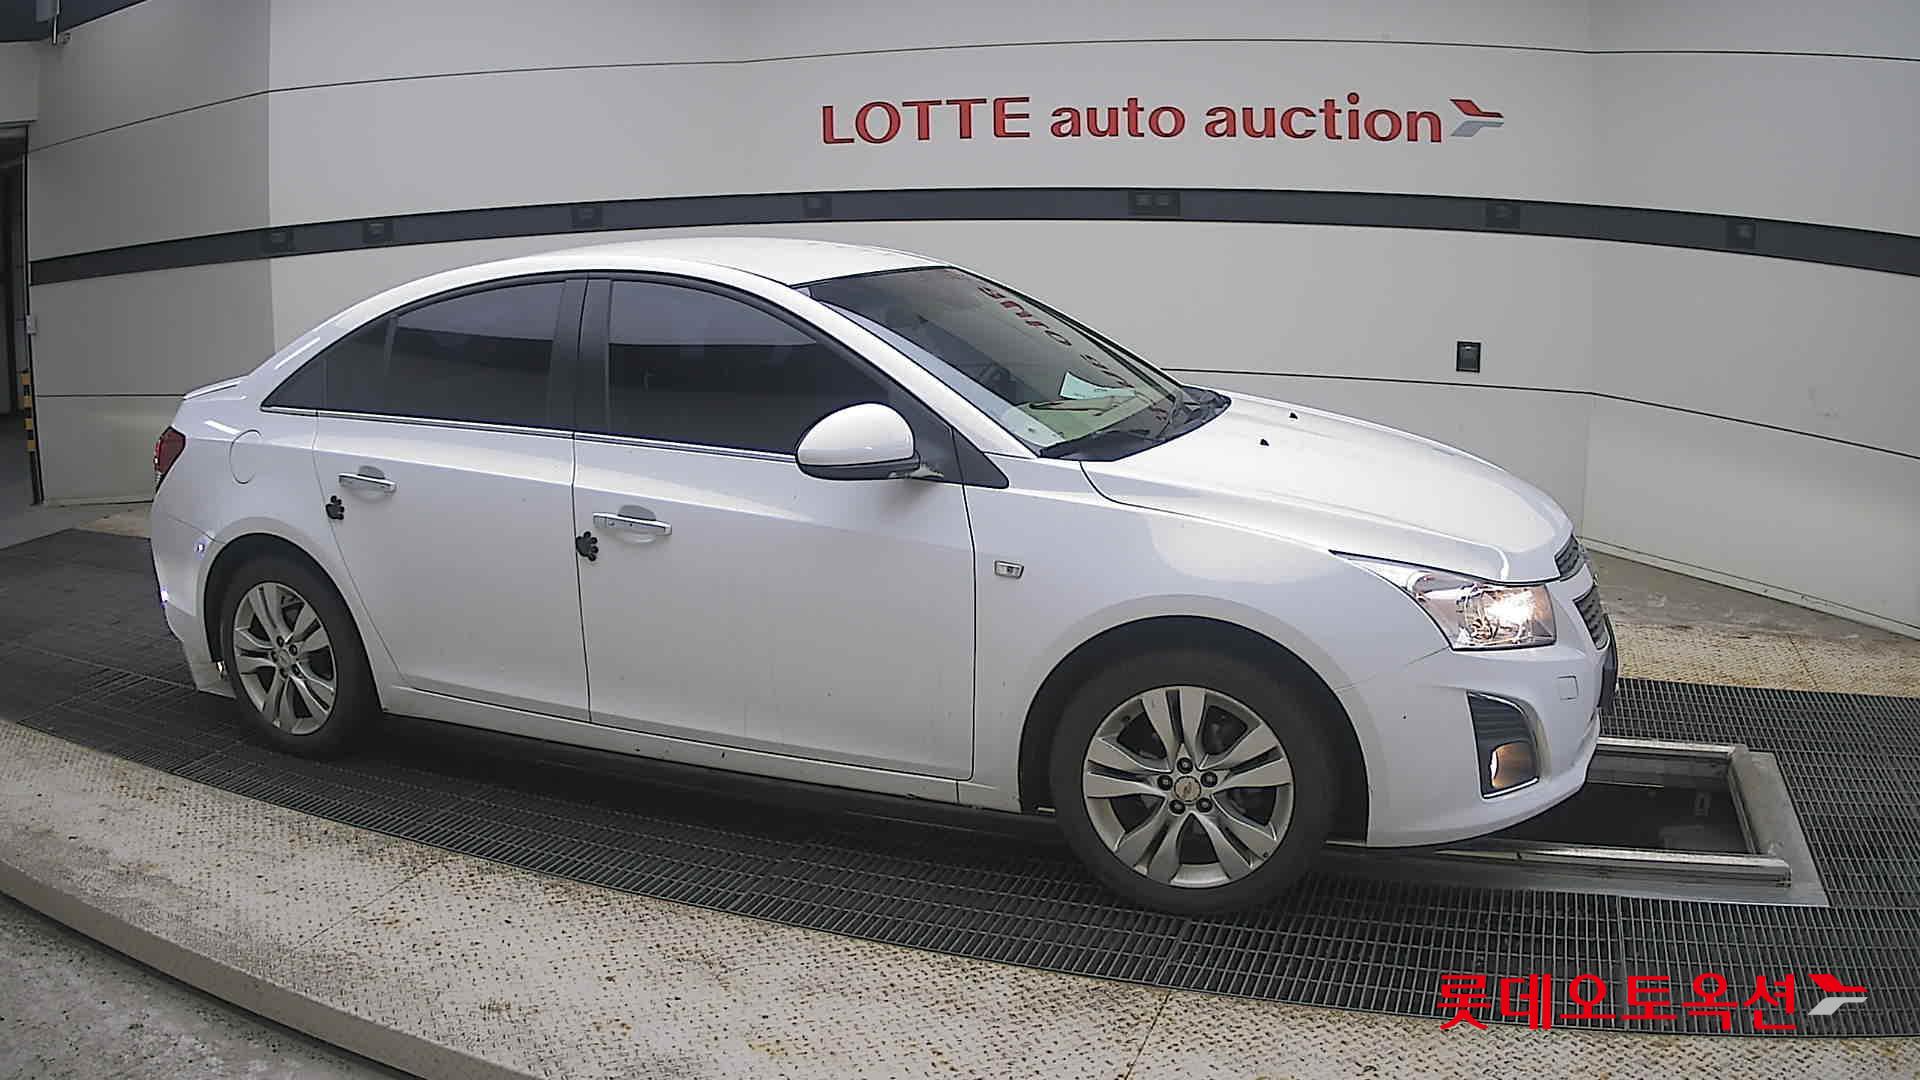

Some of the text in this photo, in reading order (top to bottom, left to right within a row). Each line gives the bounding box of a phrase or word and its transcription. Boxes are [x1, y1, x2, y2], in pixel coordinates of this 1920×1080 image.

[821, 94, 1443, 145] LOTTE auto auction
